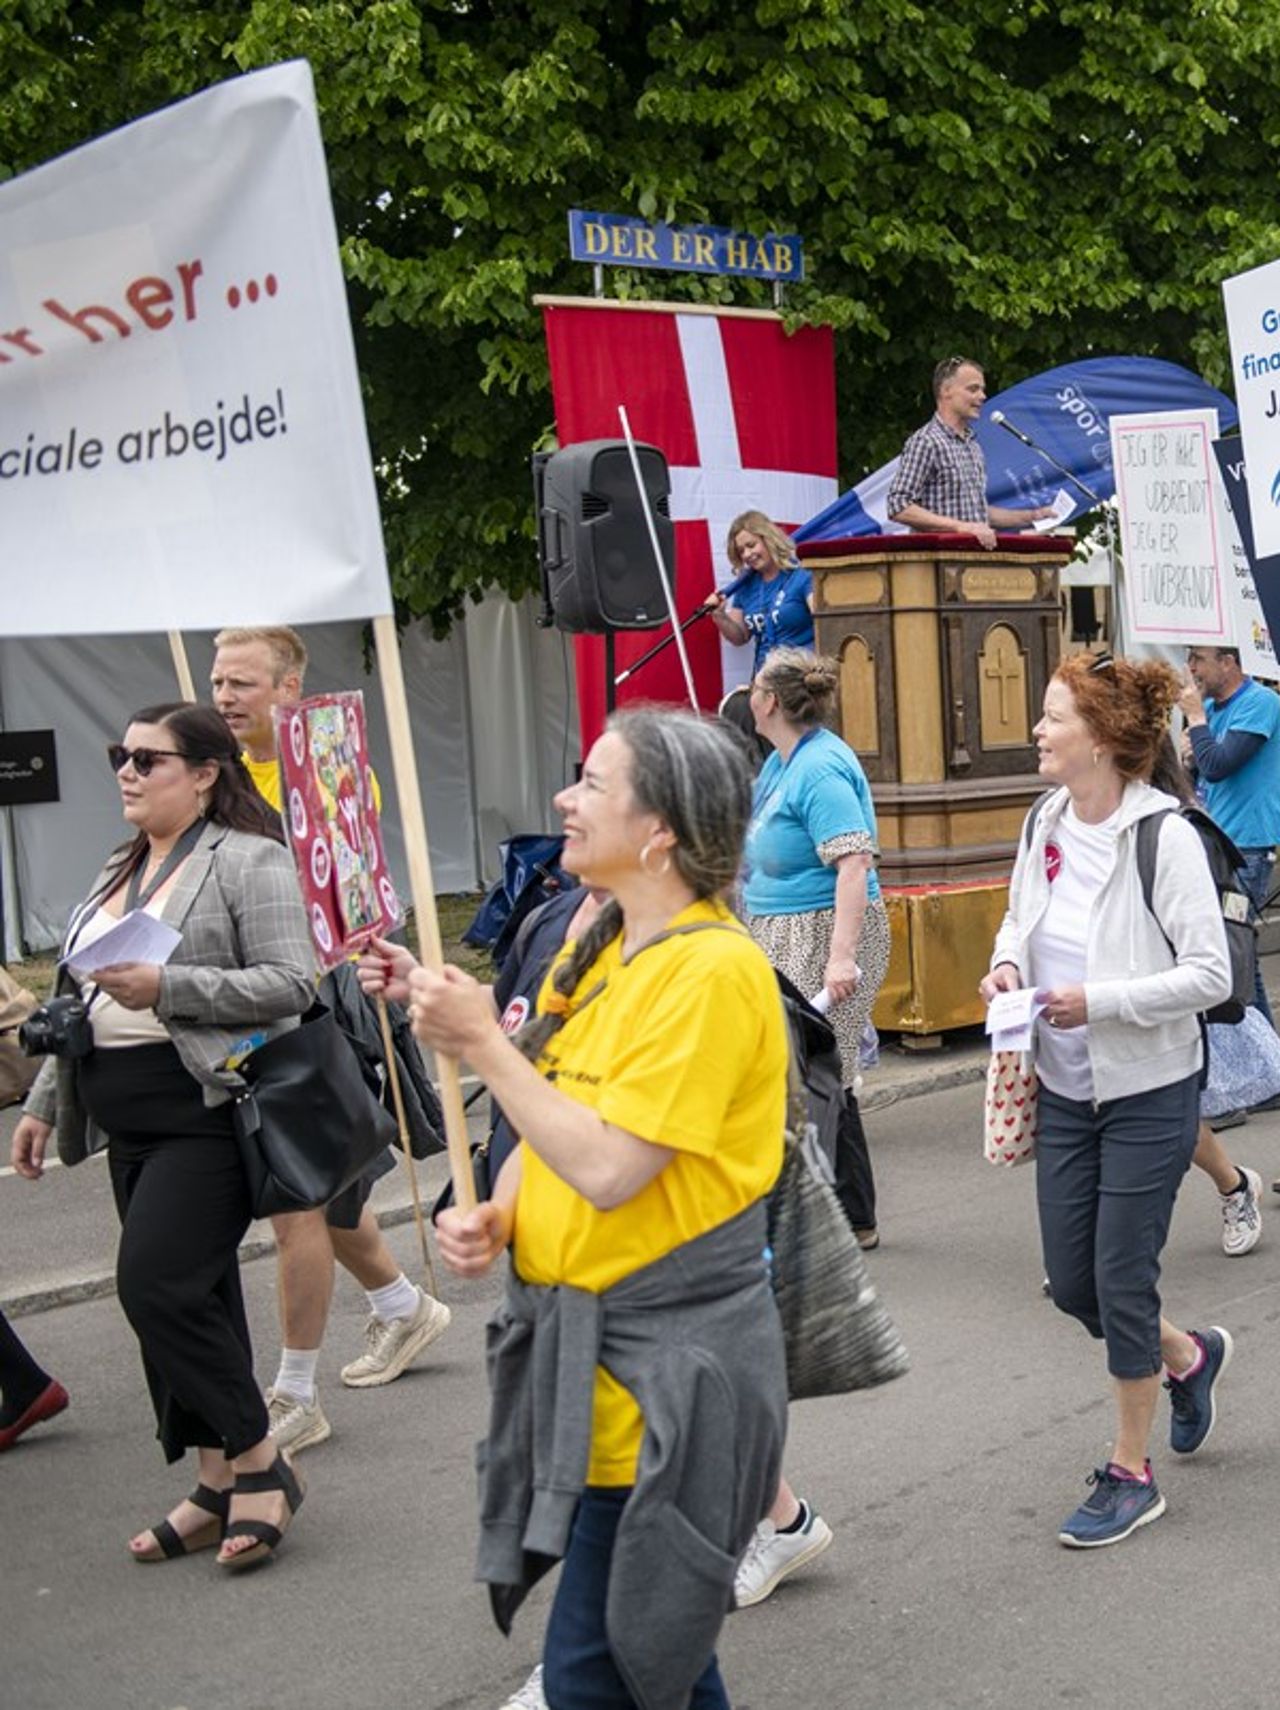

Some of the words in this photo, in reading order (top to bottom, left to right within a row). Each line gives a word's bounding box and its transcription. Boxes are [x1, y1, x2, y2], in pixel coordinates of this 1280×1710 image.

[584, 222, 659, 261] DER
[672, 230, 718, 267] ER
[117, 388, 287, 461] arbejde!
[1056, 387, 1105, 436] spor
[744, 608, 780, 632] spr
